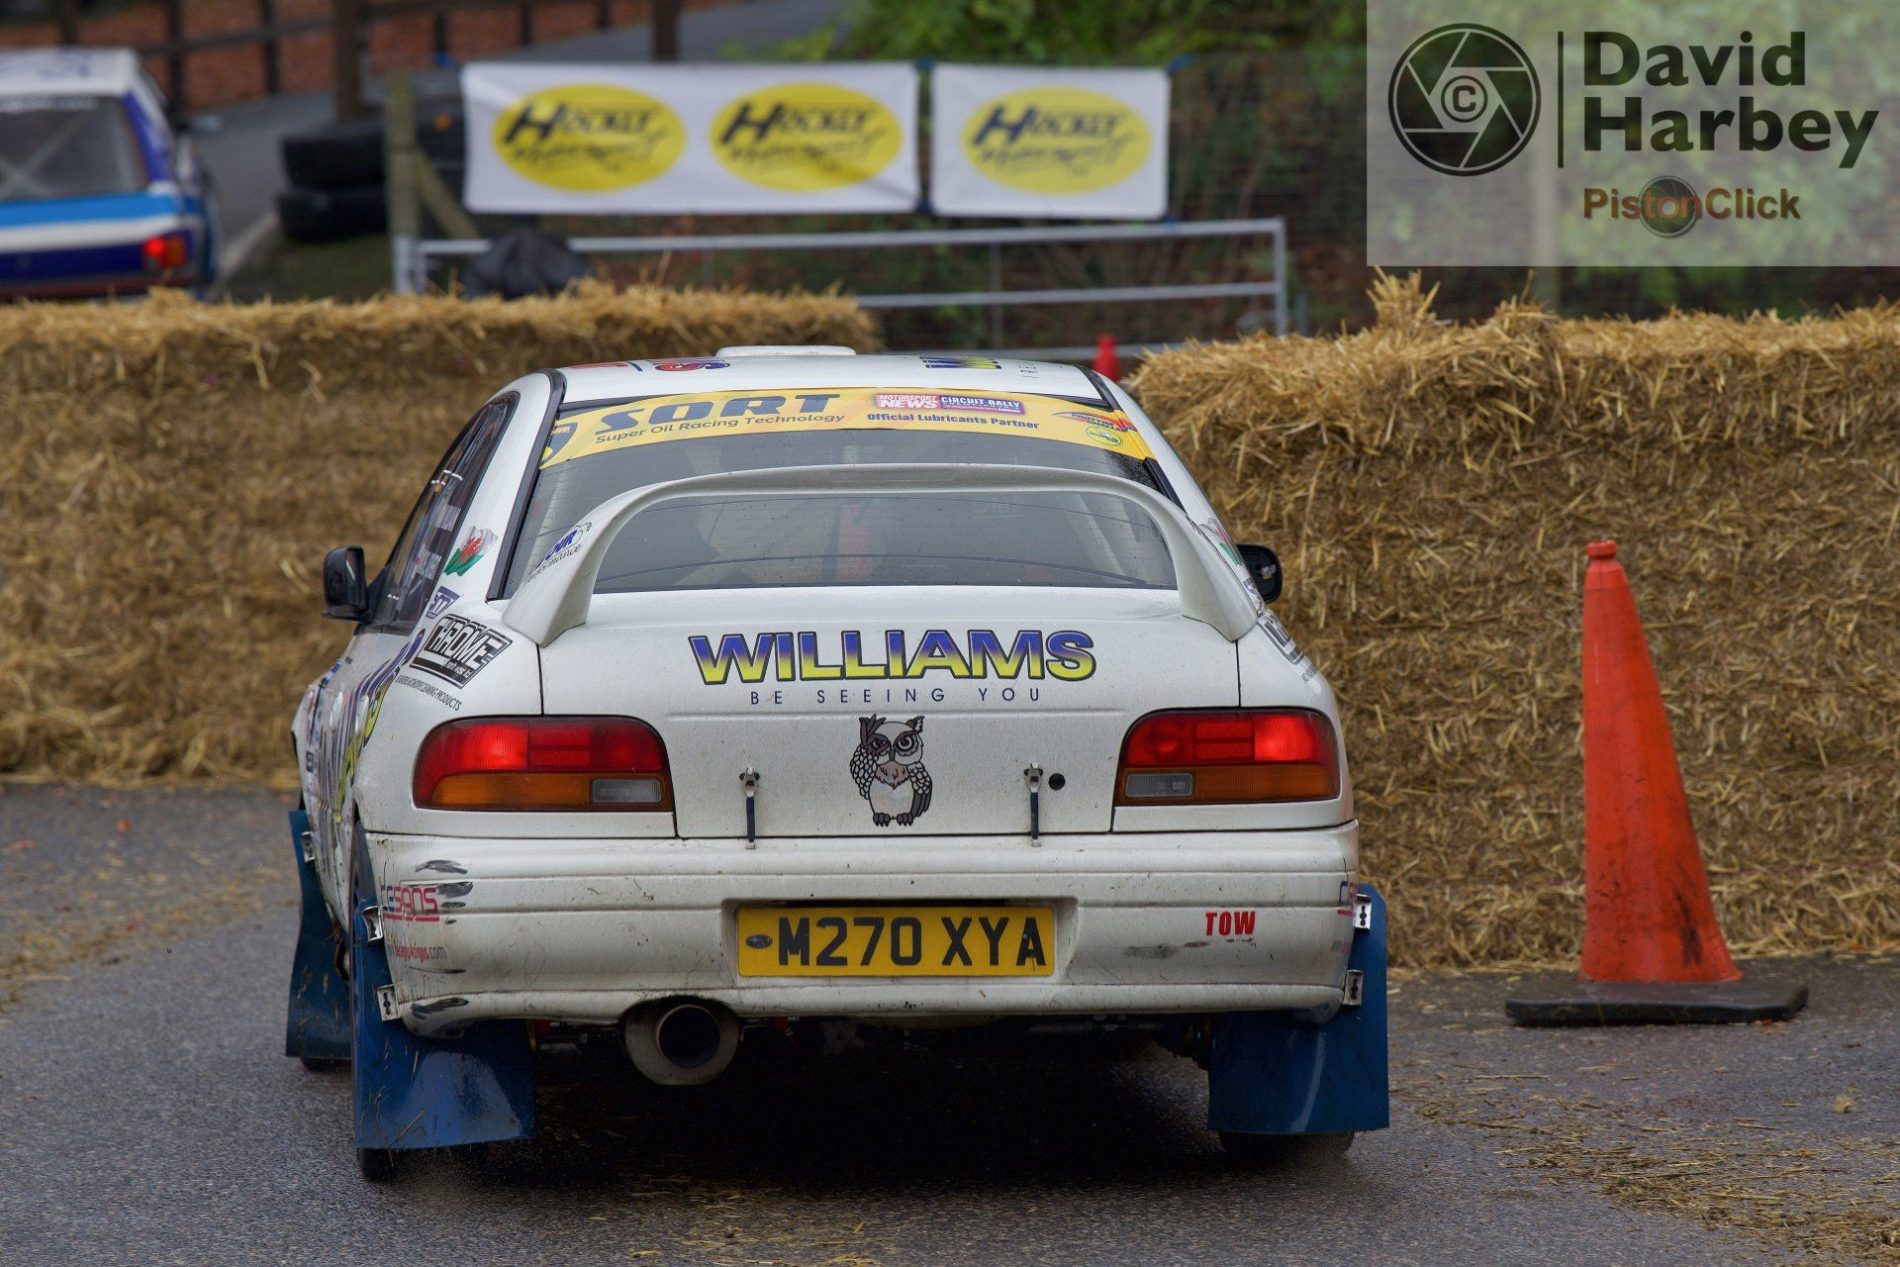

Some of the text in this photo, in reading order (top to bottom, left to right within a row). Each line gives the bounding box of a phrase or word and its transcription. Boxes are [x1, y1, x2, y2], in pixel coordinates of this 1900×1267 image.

[880, 400, 938, 408] NEWS
[940, 396, 984, 405] CIRCUIT
[988, 399, 1020, 408] RALLY
[595, 394, 841, 435] SORT
[867, 413, 1040, 429] Official Lubricants Partner
[595, 413, 845, 444] Super Oil Racing Technology
[688, 629, 1097, 685] WILLIAMS
[750, 687, 1041, 705] BE SEEING YOU
[1205, 911, 1256, 936] TOW
[778, 916, 1047, 967] M270 XYA
